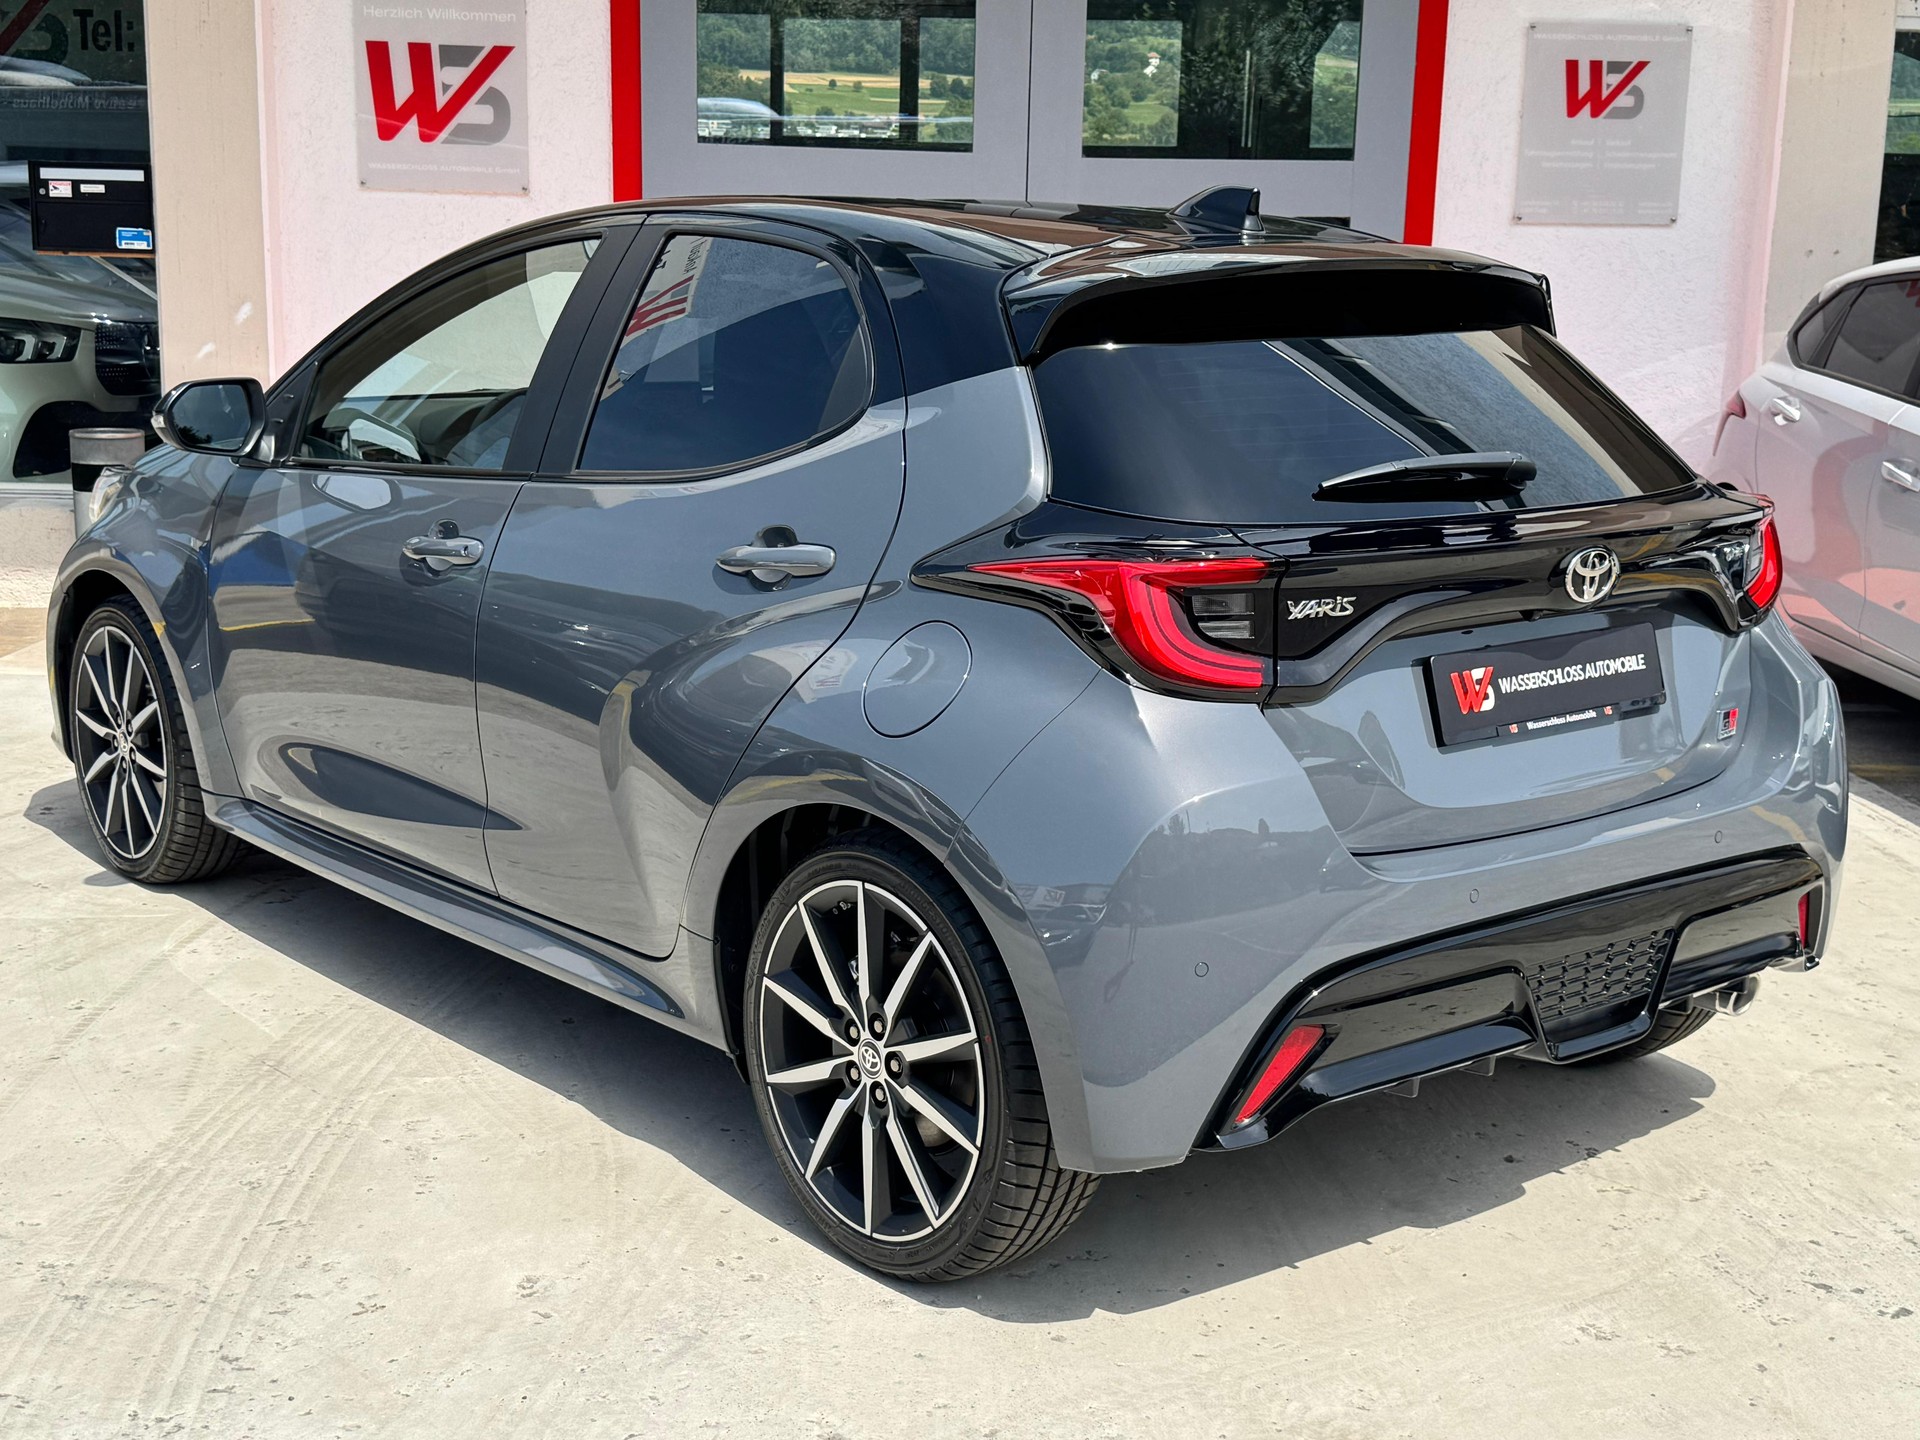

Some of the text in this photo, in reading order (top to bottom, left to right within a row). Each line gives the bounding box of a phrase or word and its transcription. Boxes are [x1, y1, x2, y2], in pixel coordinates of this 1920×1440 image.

[363, 5, 517, 23] Herzlich Willkommen
[73, 9, 135, 51] Tel:
[368, 162, 438, 172] WASSERSCHLOSS
[440, 165, 493, 174] AUTOMOBILE
[1498, 666, 1585, 694] WASSERSCHLOSS
[1585, 653, 1646, 680] AUTOMOBILE
[1526, 715, 1566, 730] Wasserschloss
[1566, 709, 1597, 723] Automobile
